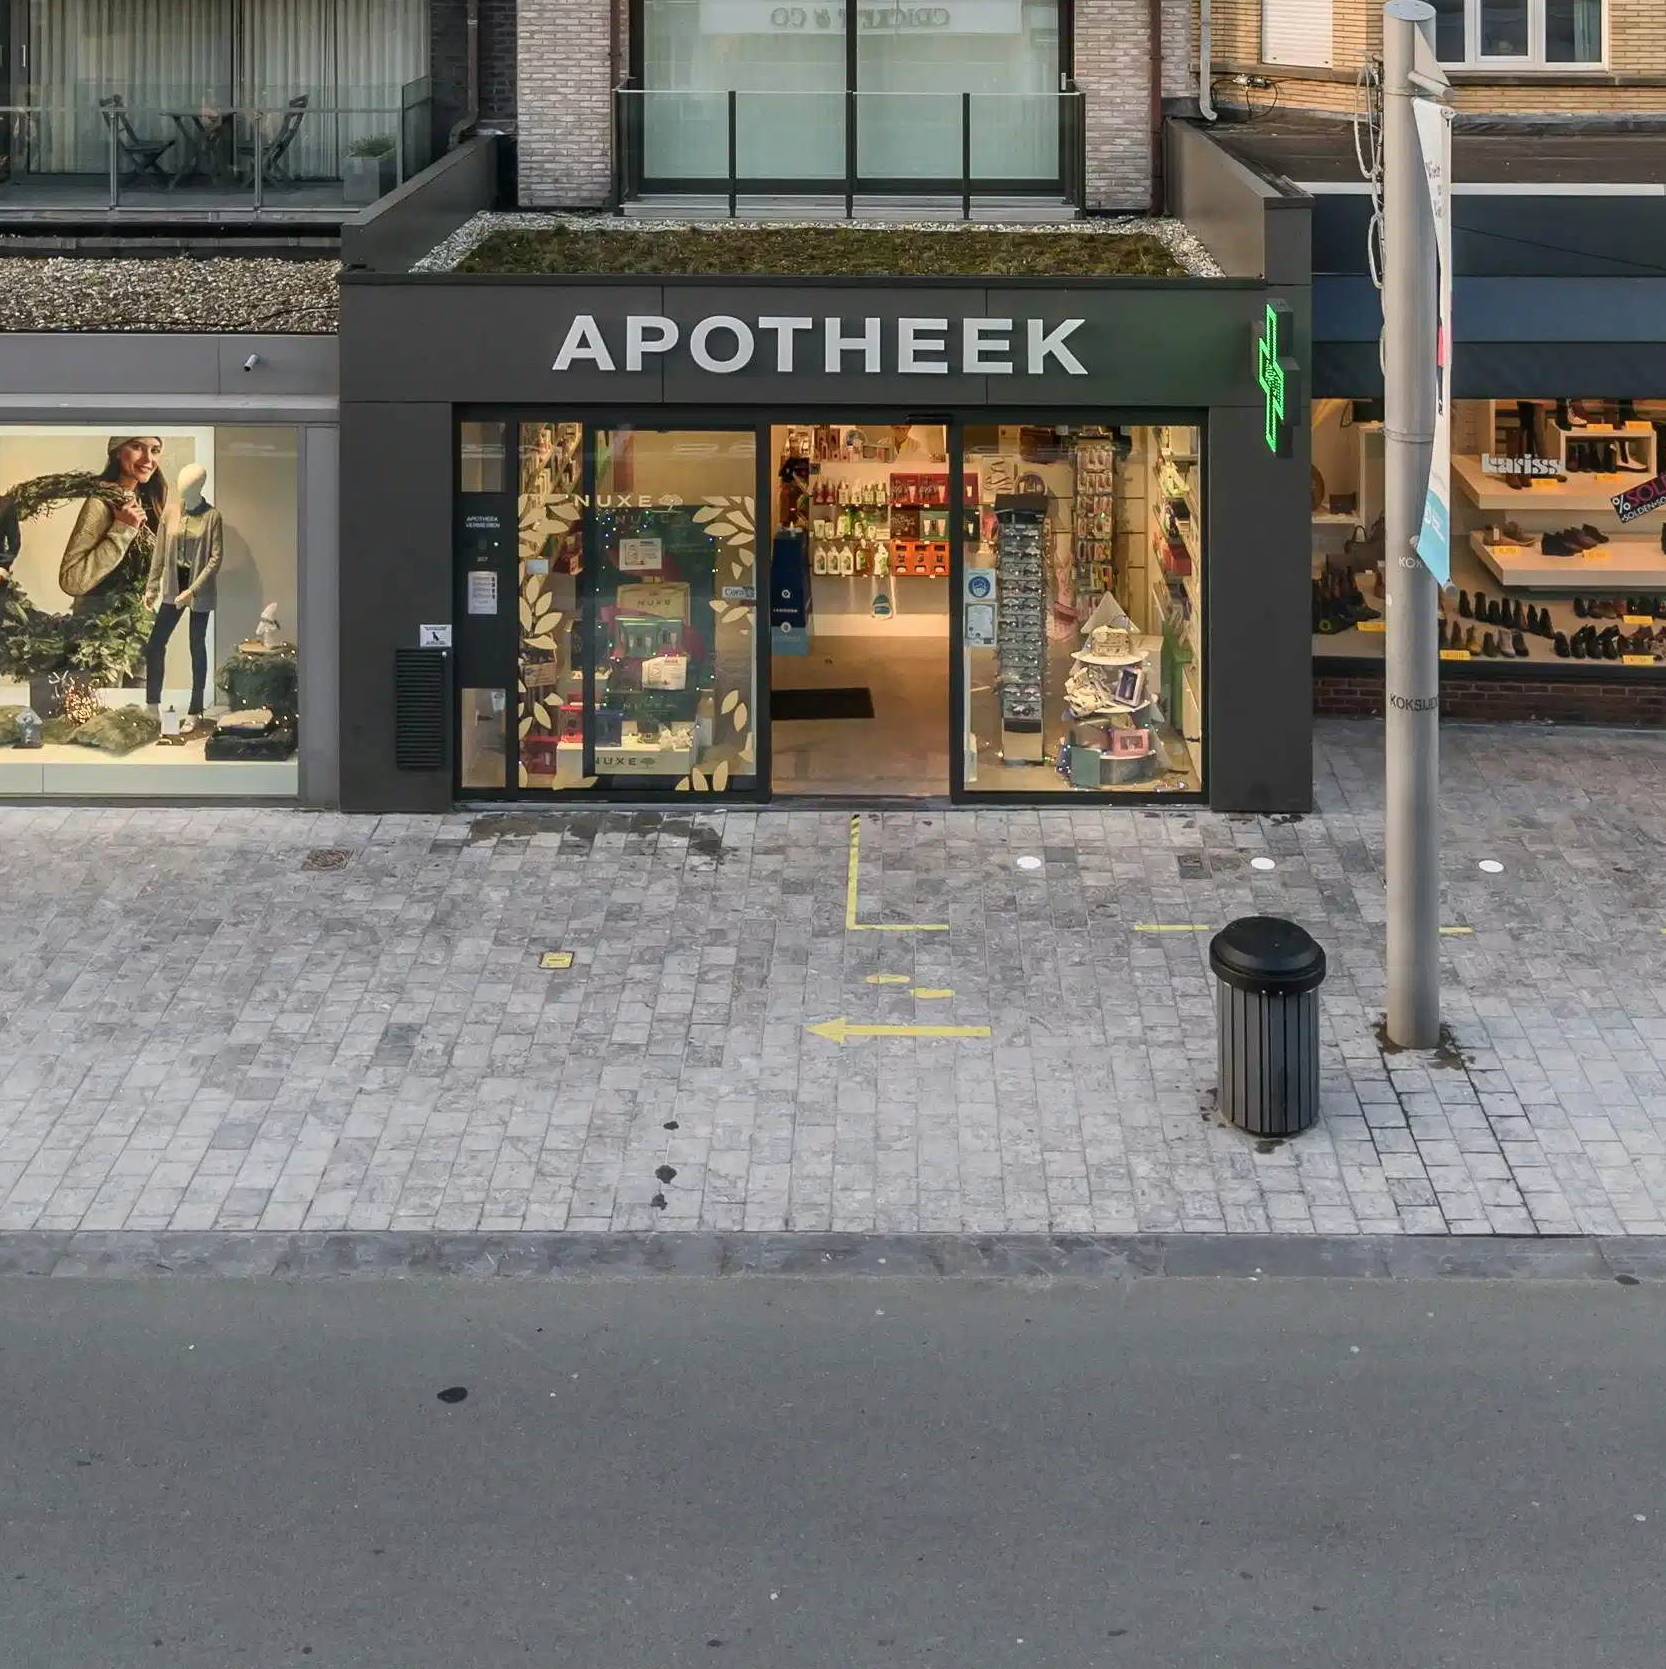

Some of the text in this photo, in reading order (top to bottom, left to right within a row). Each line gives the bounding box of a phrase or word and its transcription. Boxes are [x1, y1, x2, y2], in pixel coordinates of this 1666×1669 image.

[552, 314, 1089, 375] APOTHEEK
[1481, 453, 1564, 475] kariss
[574, 495, 652, 508] NUXE
